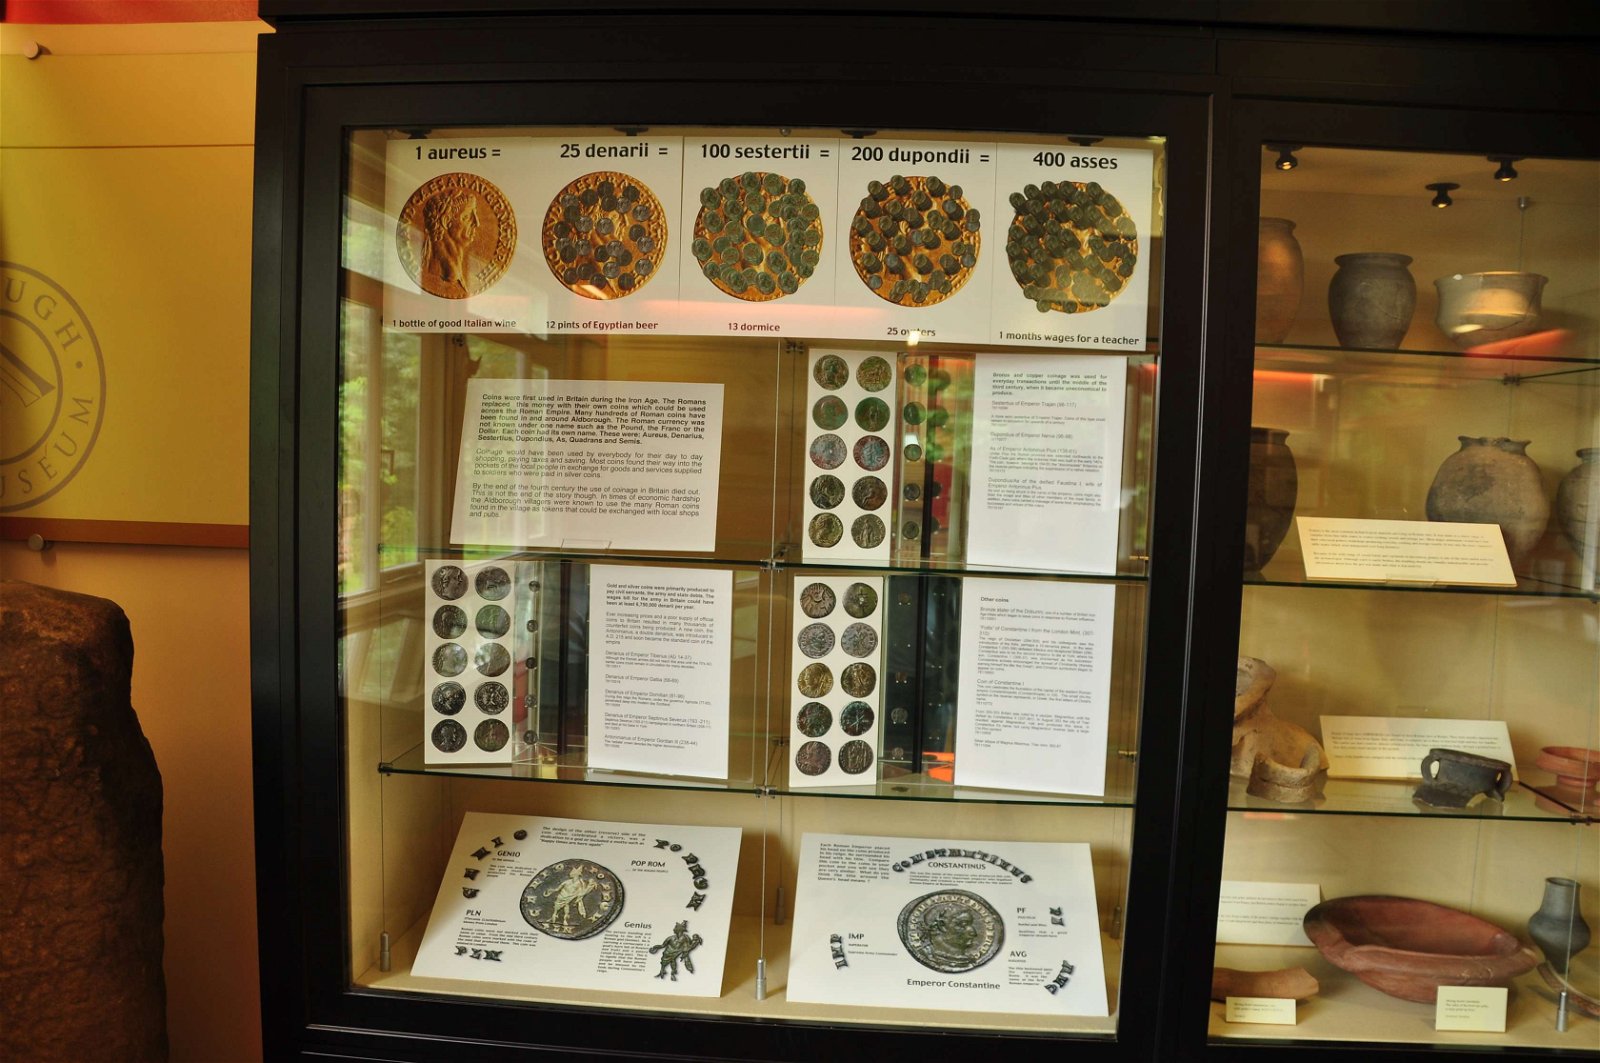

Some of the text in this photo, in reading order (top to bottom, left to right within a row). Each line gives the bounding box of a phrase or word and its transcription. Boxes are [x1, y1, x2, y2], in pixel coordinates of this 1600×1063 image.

[416, 146, 421, 160] 1
[428, 146, 487, 159] aureus
[560, 144, 580, 158] 25
[586, 143, 648, 157] denarii
[702, 144, 730, 158] 100
[735, 144, 809, 158] sestertii
[851, 146, 883, 162] 200
[889, 148, 969, 165] dupondii
[1033, 152, 1118, 169] 400 asses
[439, 320, 461, 329] good
[558, 321, 579, 330] pints
[593, 321, 634, 330] Egyptian
[741, 323, 780, 331] dormice
[900, 328, 936, 337] oers
[1006, 332, 1042, 340] months
[1044, 334, 1074, 343] wages
[1077, 334, 1091, 343] for
[1102, 336, 1139, 345] teacher
[928, 862, 986, 870] CONSTANTINUS
[907, 979, 1000, 990] Emperor Constantine
